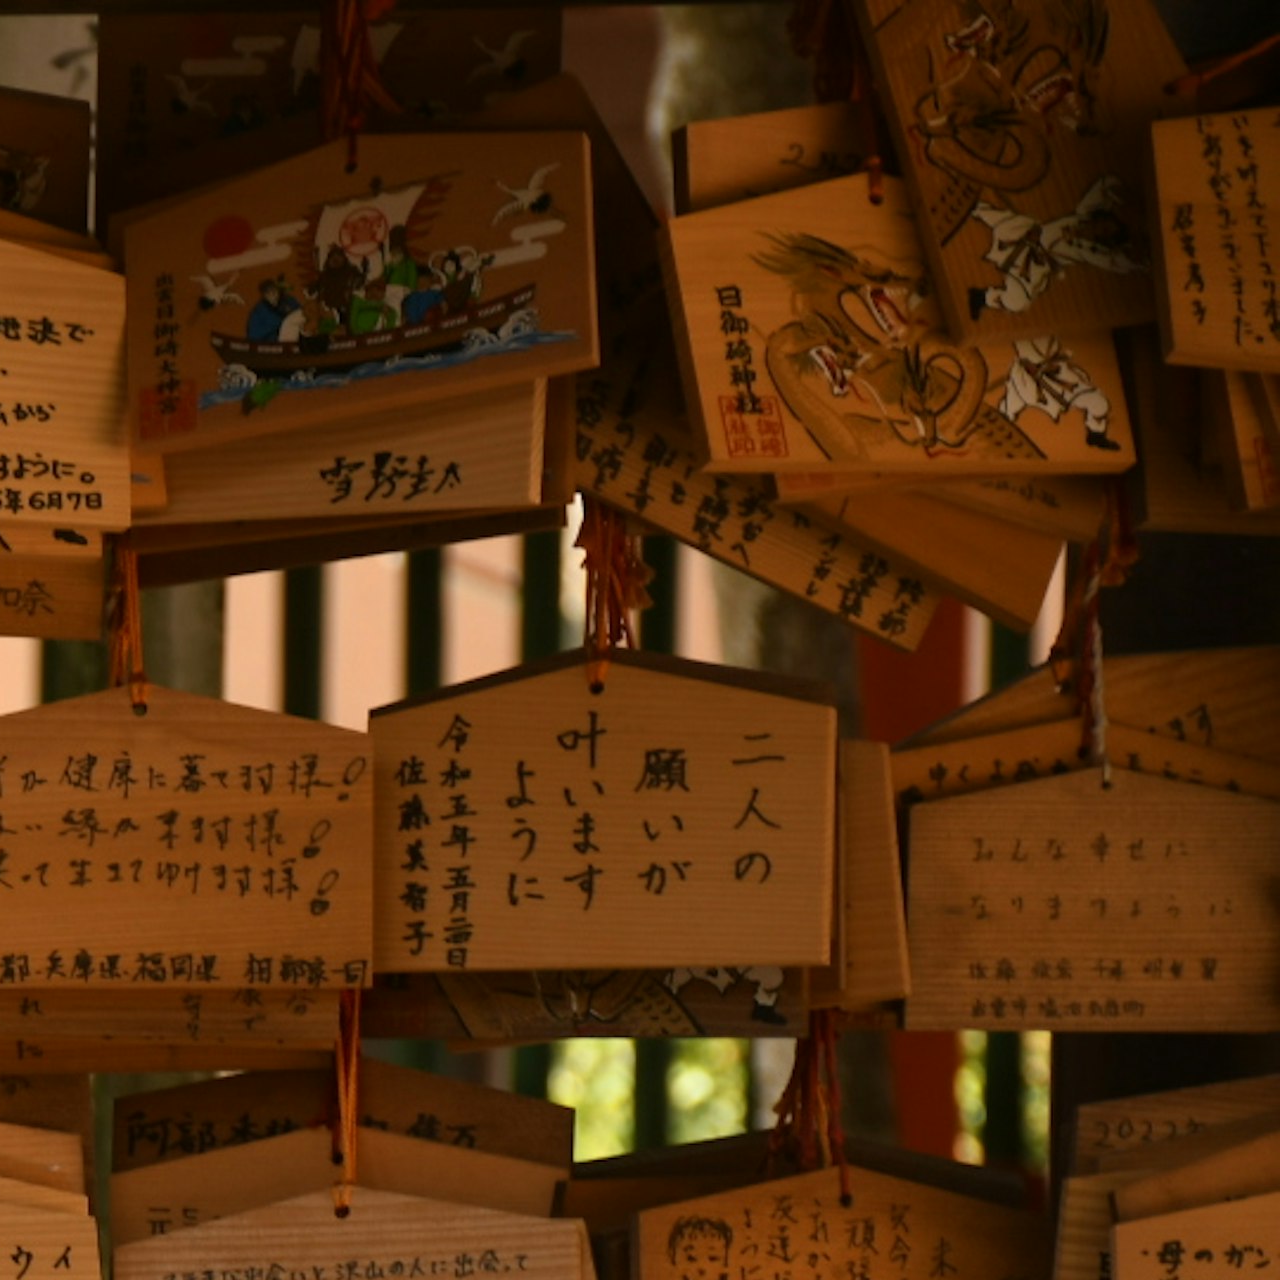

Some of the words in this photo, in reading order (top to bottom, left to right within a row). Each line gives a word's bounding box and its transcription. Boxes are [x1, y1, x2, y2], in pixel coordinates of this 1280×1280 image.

[505, 759, 548, 907] ように
[555, 710, 608, 911] 叶います
[633, 748, 692, 895] 願いが
[730, 732, 786, 885] 二人の
